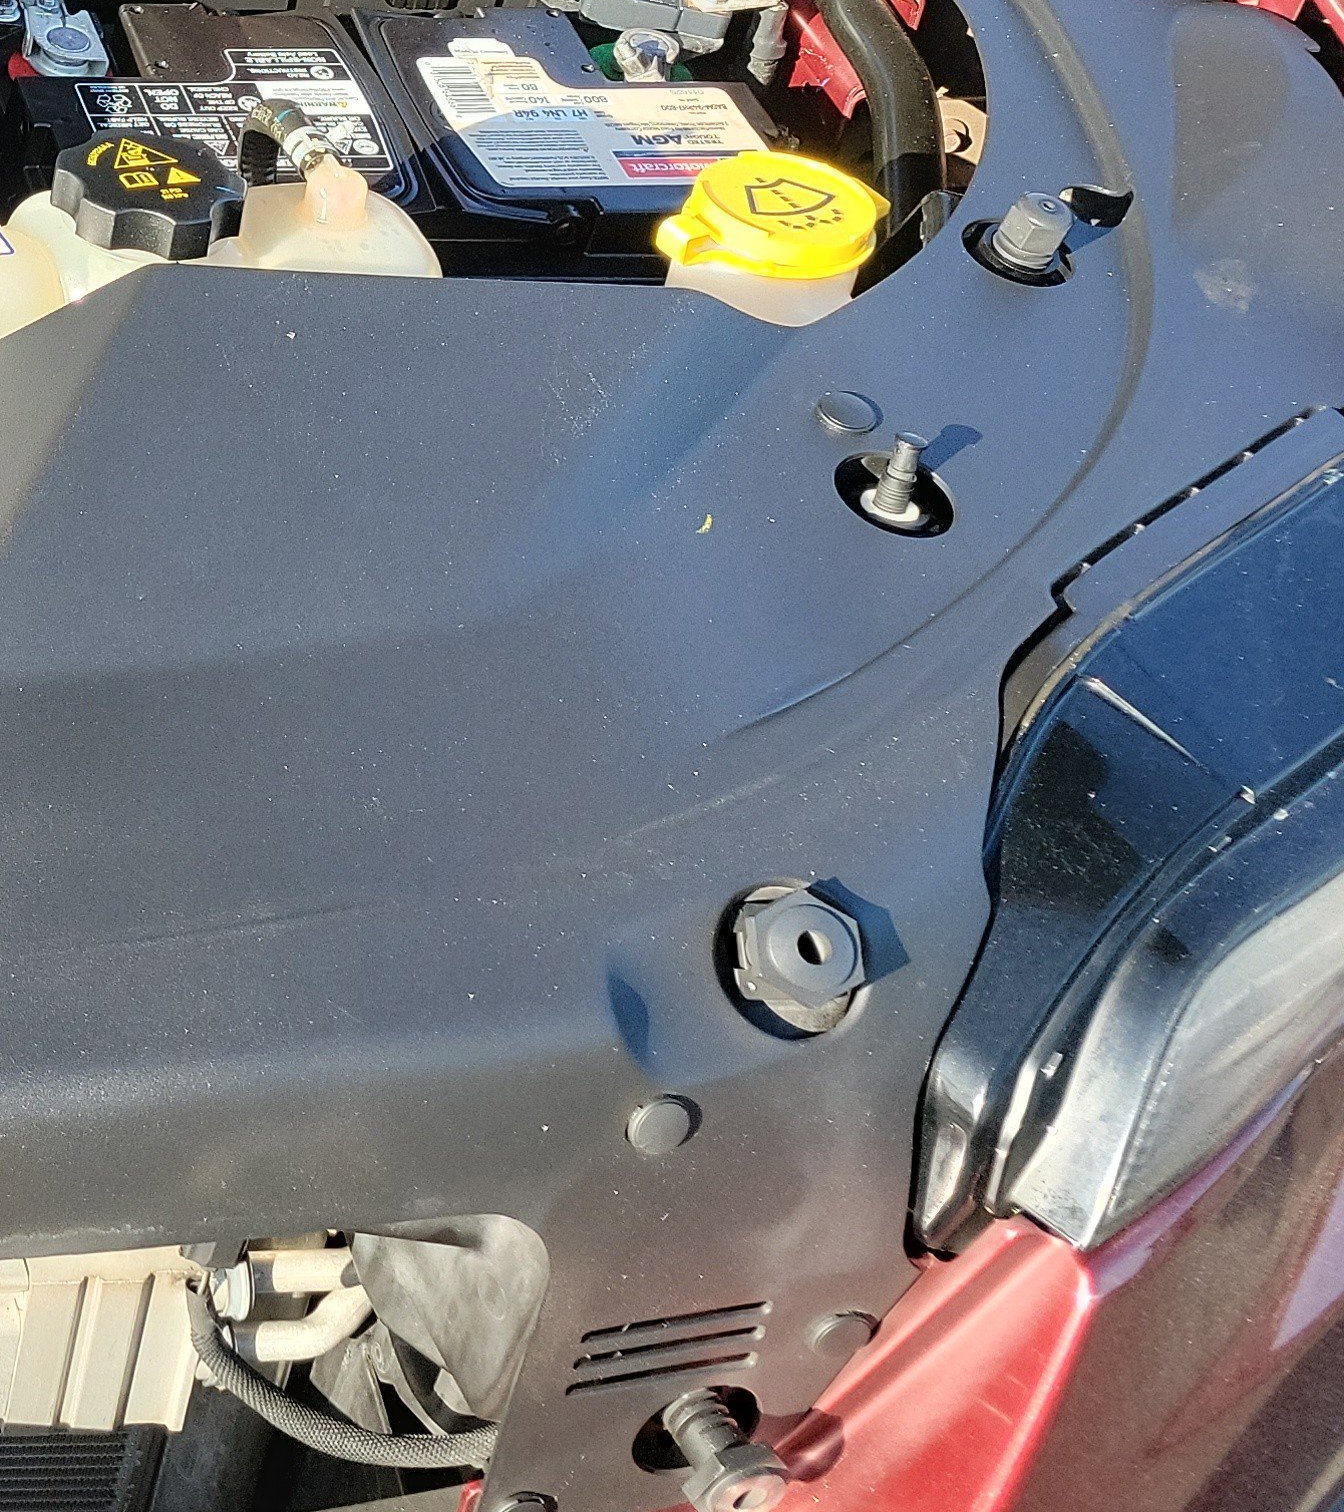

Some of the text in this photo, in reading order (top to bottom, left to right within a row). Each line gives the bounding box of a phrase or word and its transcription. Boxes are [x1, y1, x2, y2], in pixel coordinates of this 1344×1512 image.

[144, 88, 179, 96] OPEN.
[154, 95, 178, 103] NOT
[528, 96, 550, 104] 140
[583, 95, 609, 104] 800
[512, 109, 539, 118] 94R
[542, 109, 567, 118] LN4
[571, 109, 589, 118] H7
[630, 134, 682, 145] AGM
